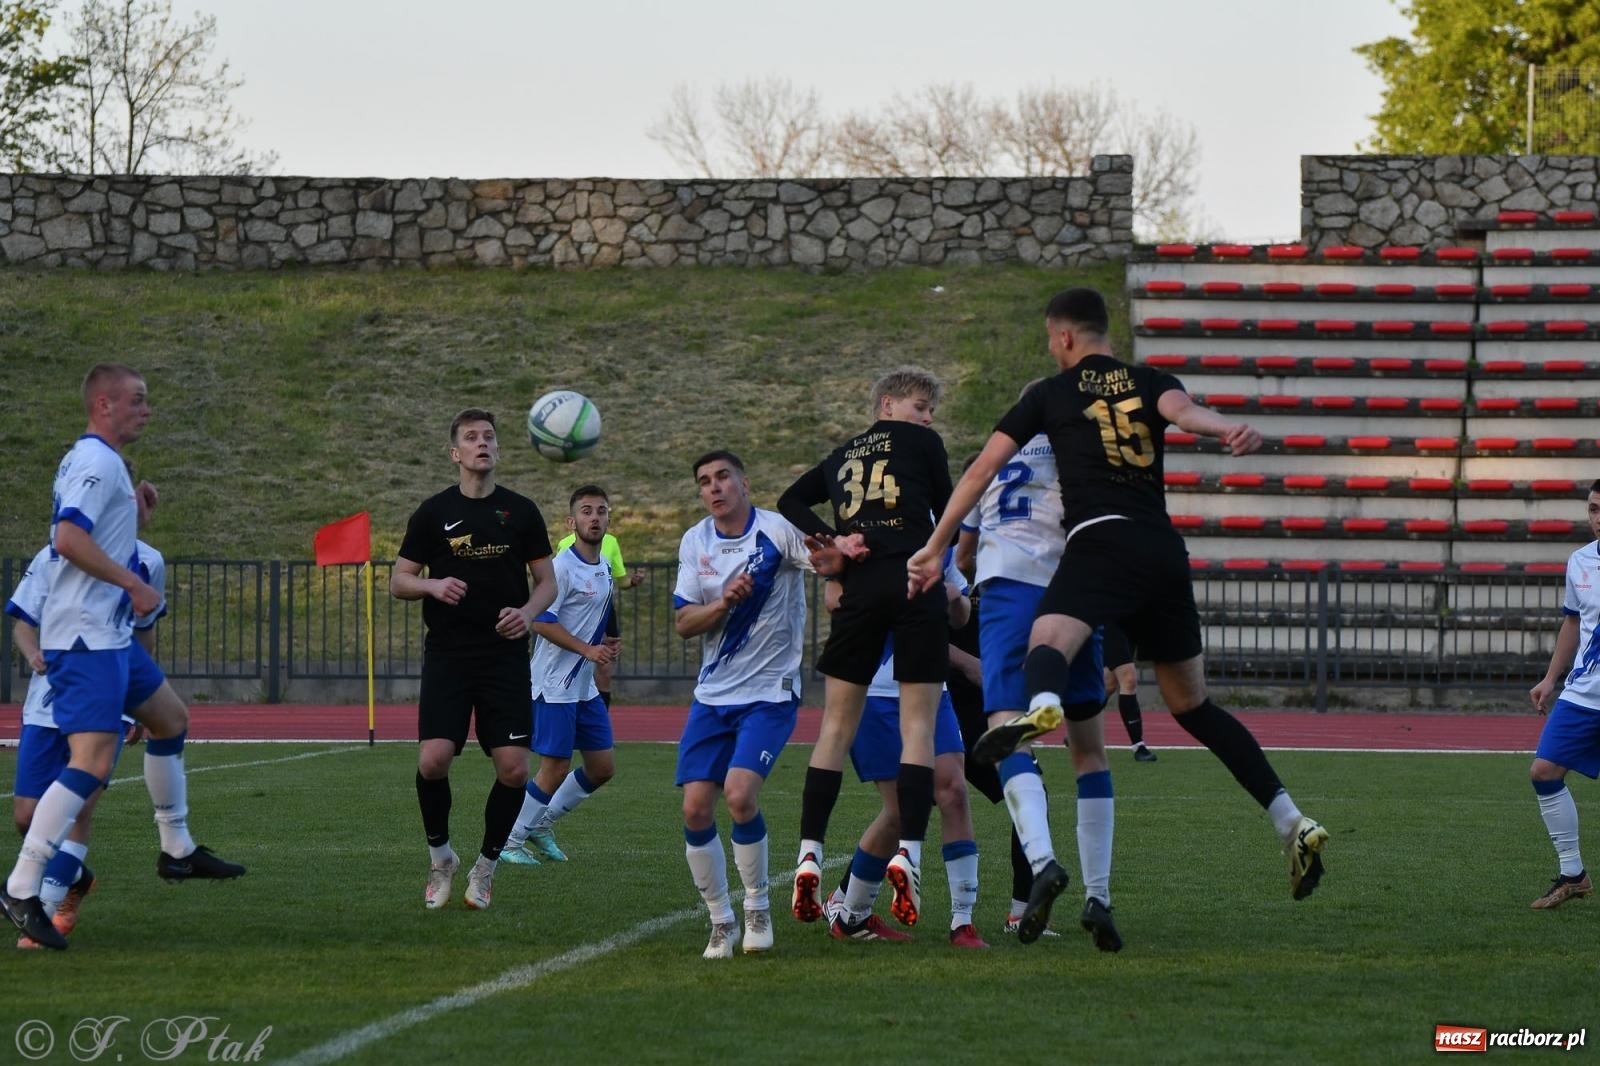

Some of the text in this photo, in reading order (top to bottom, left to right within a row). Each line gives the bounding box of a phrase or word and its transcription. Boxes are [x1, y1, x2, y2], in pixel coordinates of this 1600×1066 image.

[1081, 367, 1129, 384] CZARNI
[1082, 396, 1156, 468] 15
[836, 458, 900, 521] 34
[997, 460, 1034, 522] 2
